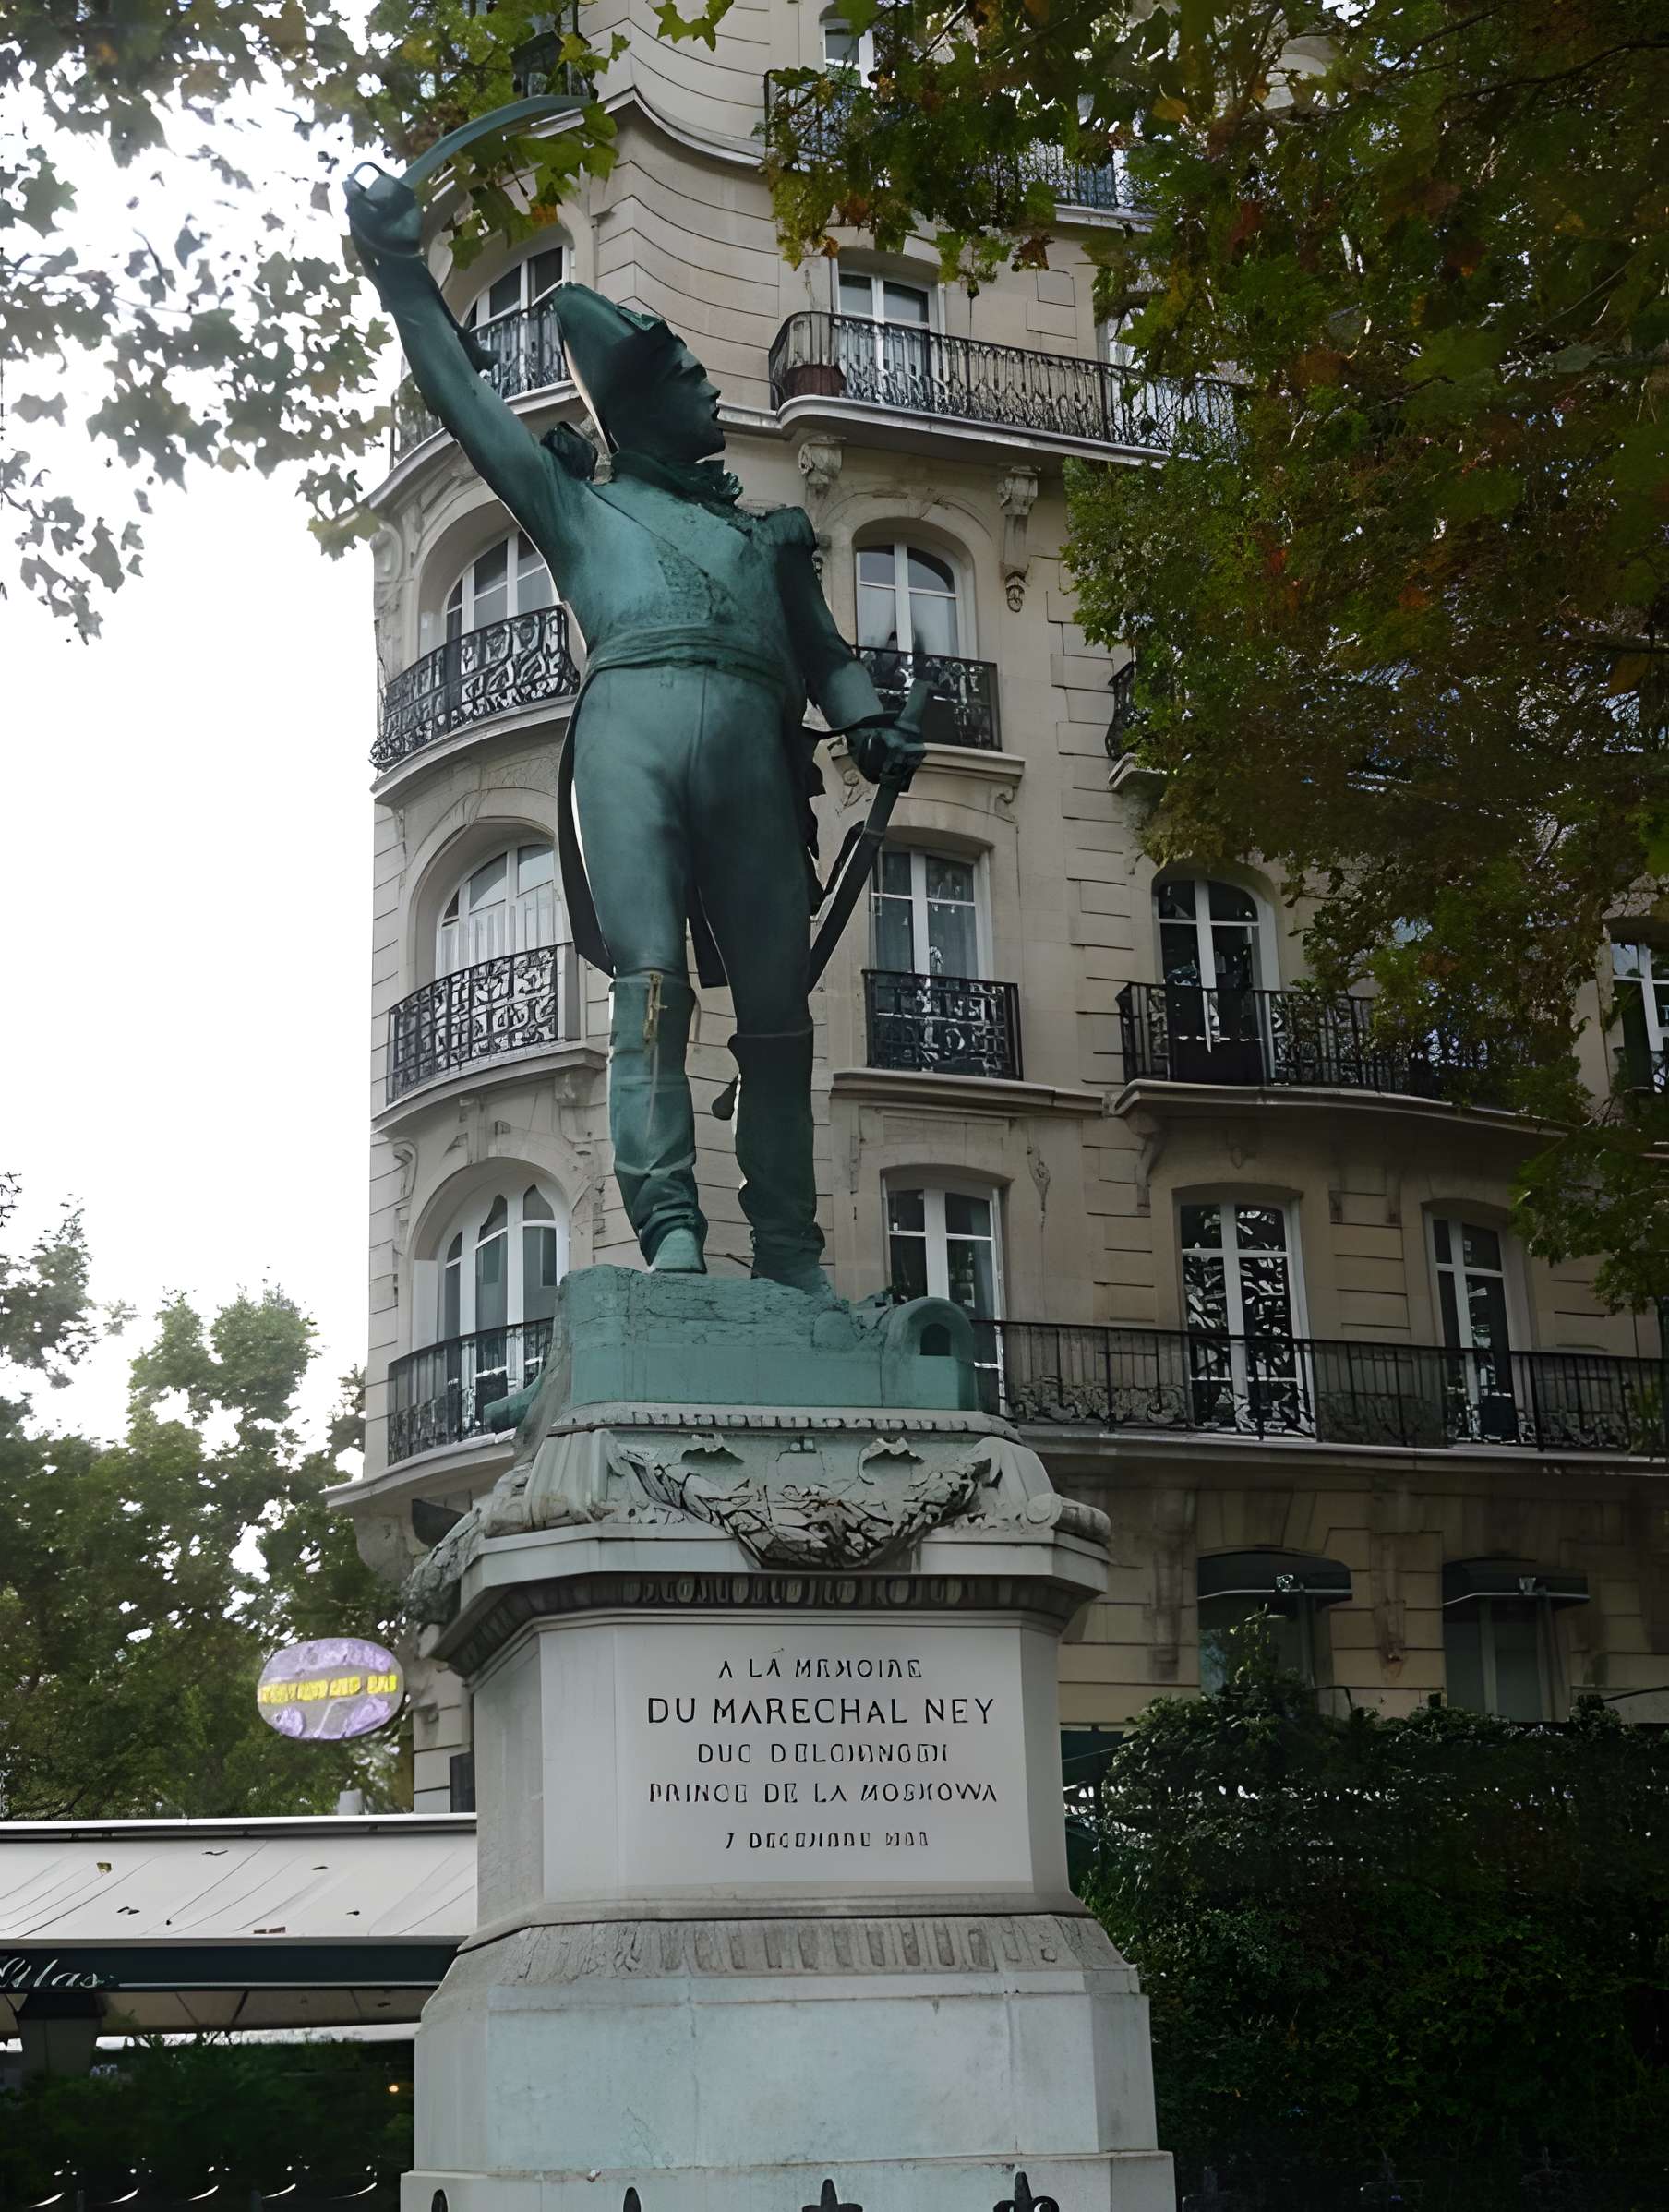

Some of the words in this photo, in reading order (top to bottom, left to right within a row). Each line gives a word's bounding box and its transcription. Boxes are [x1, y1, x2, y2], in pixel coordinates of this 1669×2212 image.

[647, 1697, 696, 1724] DU
[713, 1697, 908, 1725] MARECHAL
[925, 1698, 994, 1725] NEY
[814, 1782, 847, 1803] LA
